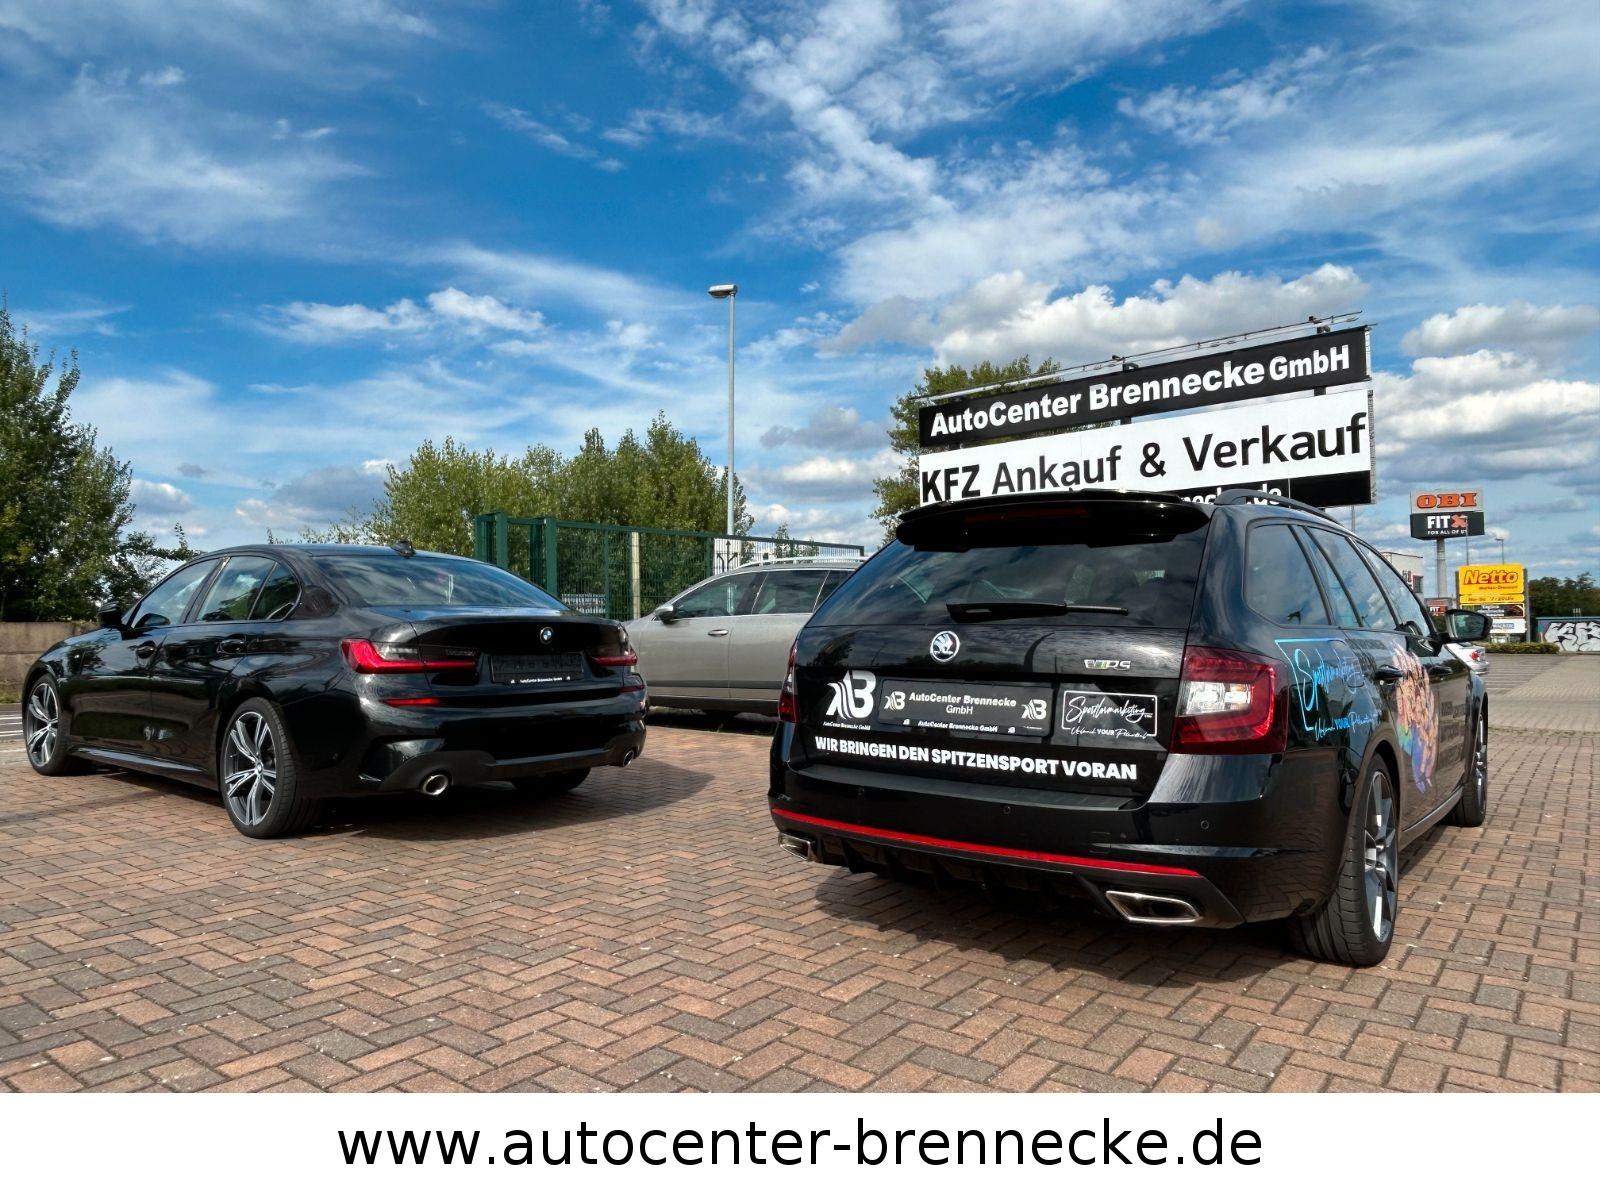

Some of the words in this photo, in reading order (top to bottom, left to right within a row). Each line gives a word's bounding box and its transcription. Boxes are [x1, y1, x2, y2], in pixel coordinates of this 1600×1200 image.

[930, 391, 1083, 438] AutoCenter
[1088, 360, 1264, 411] Brennecke
[1269, 344, 1350, 381] GmbH
[922, 463, 981, 503] KFZ
[993, 445, 1122, 494] Ankauf
[1139, 442, 1167, 478] &
[1182, 412, 1367, 472] Verkauf
[1416, 493, 1477, 509] OBI
[1464, 570, 1518, 585] Netto
[909, 691, 961, 704] AutoCenter
[963, 695, 1017, 707] Brennecke
[946, 704, 974, 715] GmbH
[1097, 728, 1115, 736] YOUR
[815, 736, 838, 752] WIR
[839, 739, 896, 759] BRINGEN
[898, 745, 929, 762] DEN
[931, 749, 1059, 776] SPITZENSPORT
[1061, 760, 1137, 780] VORAN
